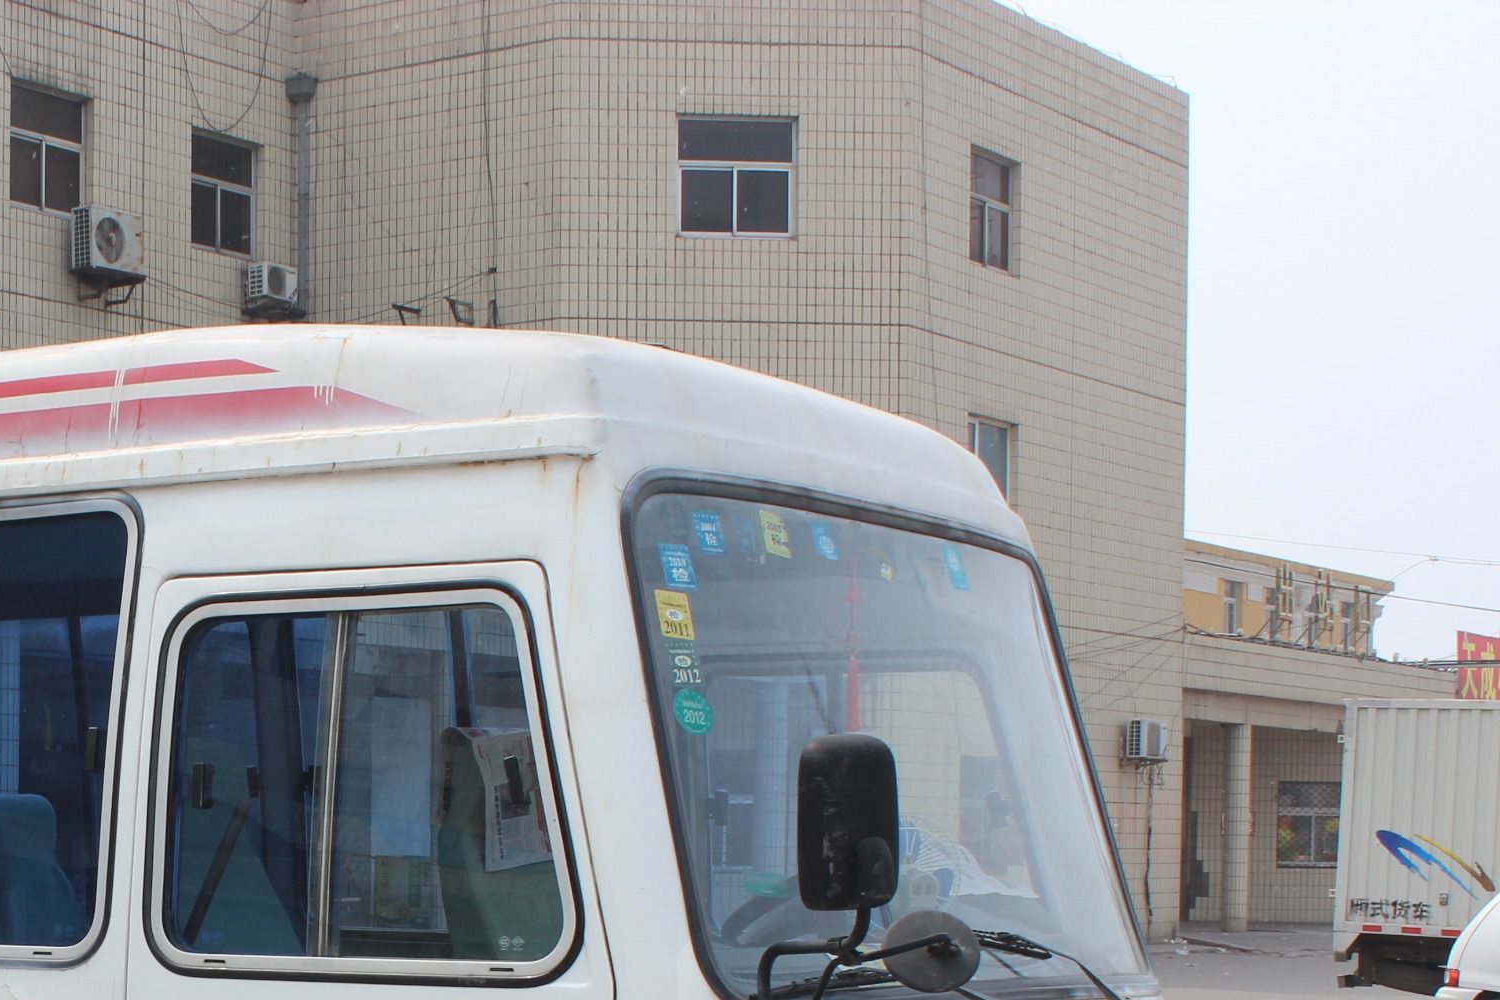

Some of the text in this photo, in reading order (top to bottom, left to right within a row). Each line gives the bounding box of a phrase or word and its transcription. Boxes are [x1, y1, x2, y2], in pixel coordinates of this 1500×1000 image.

[663, 620, 691, 638] 2011
[672, 668, 702, 684] 2012
[683, 708, 707, 725] 2012
